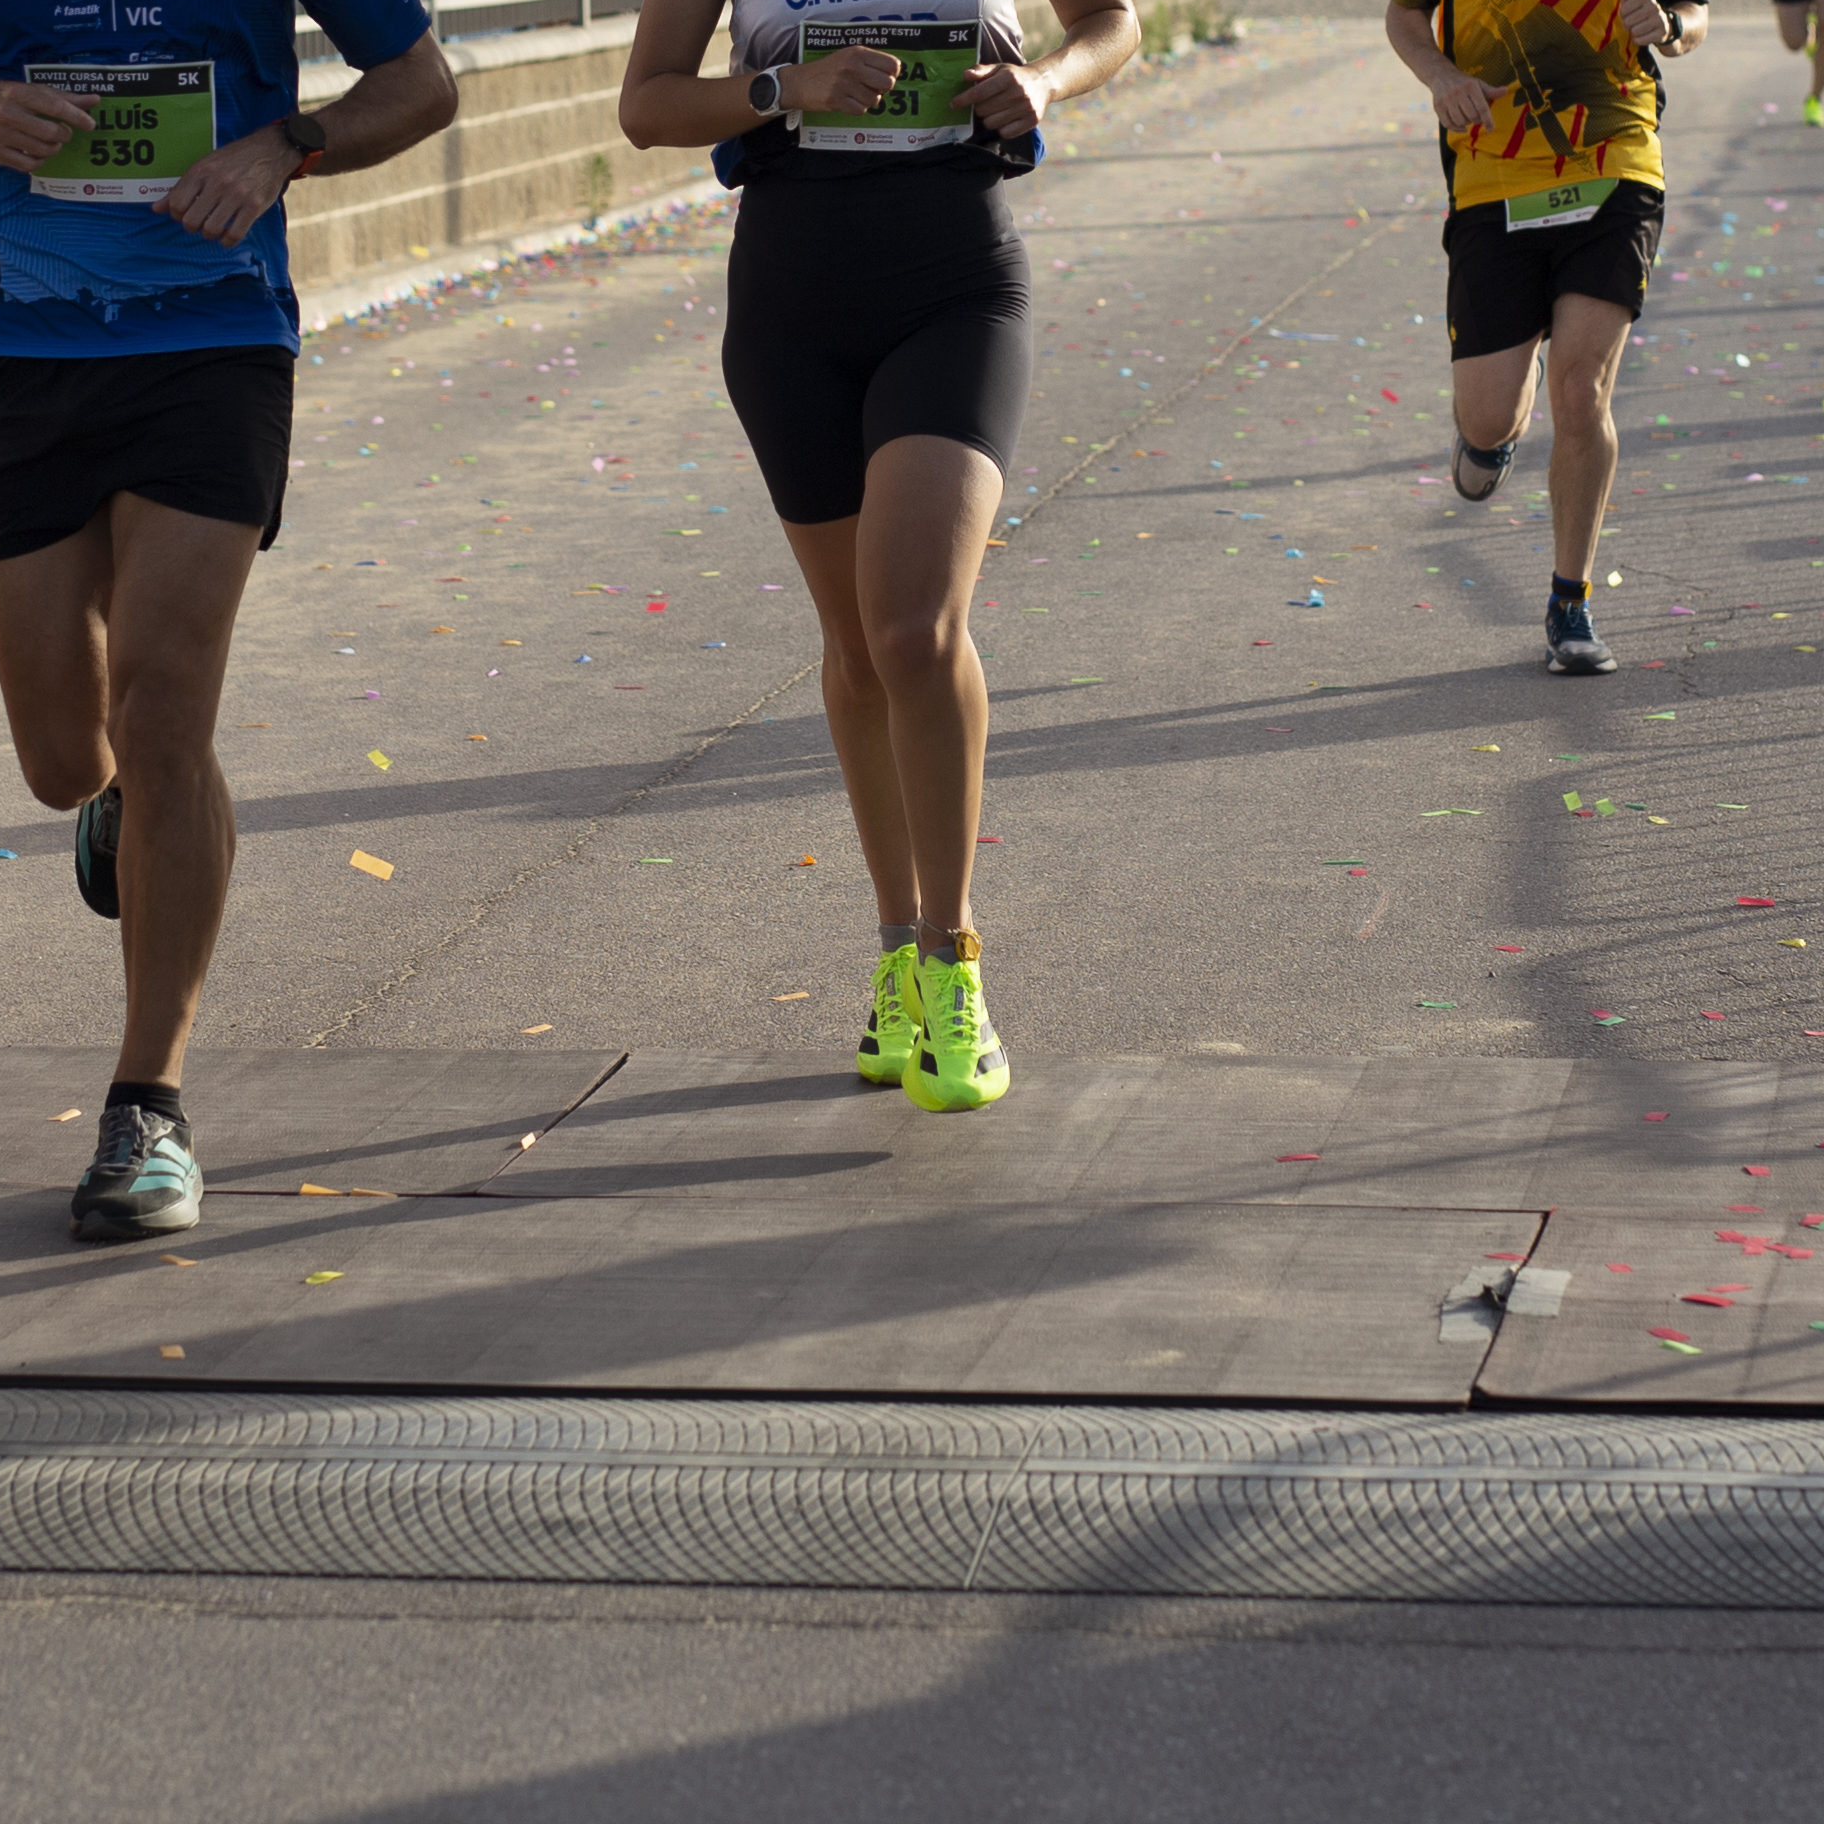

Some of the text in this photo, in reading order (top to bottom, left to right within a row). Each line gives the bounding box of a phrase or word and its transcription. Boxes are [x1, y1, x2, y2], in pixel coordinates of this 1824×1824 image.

[64, 4, 100, 16] fanatik
[126, 6, 162, 26] VIC
[807, 28, 969, 43] XXVIII CURSA D'ESTIU 5K
[807, 37, 888, 46] PREMIÀ DE MAR
[33, 72, 200, 86] XXVIII CURSA D'ESTIU 5K
[74, 84, 88, 92] DE
[91, 84, 115, 92] MAR
[88, 103, 159, 131] LUÍS
[89, 139, 155, 166] 530
[1548, 186, 1582, 208] 521
